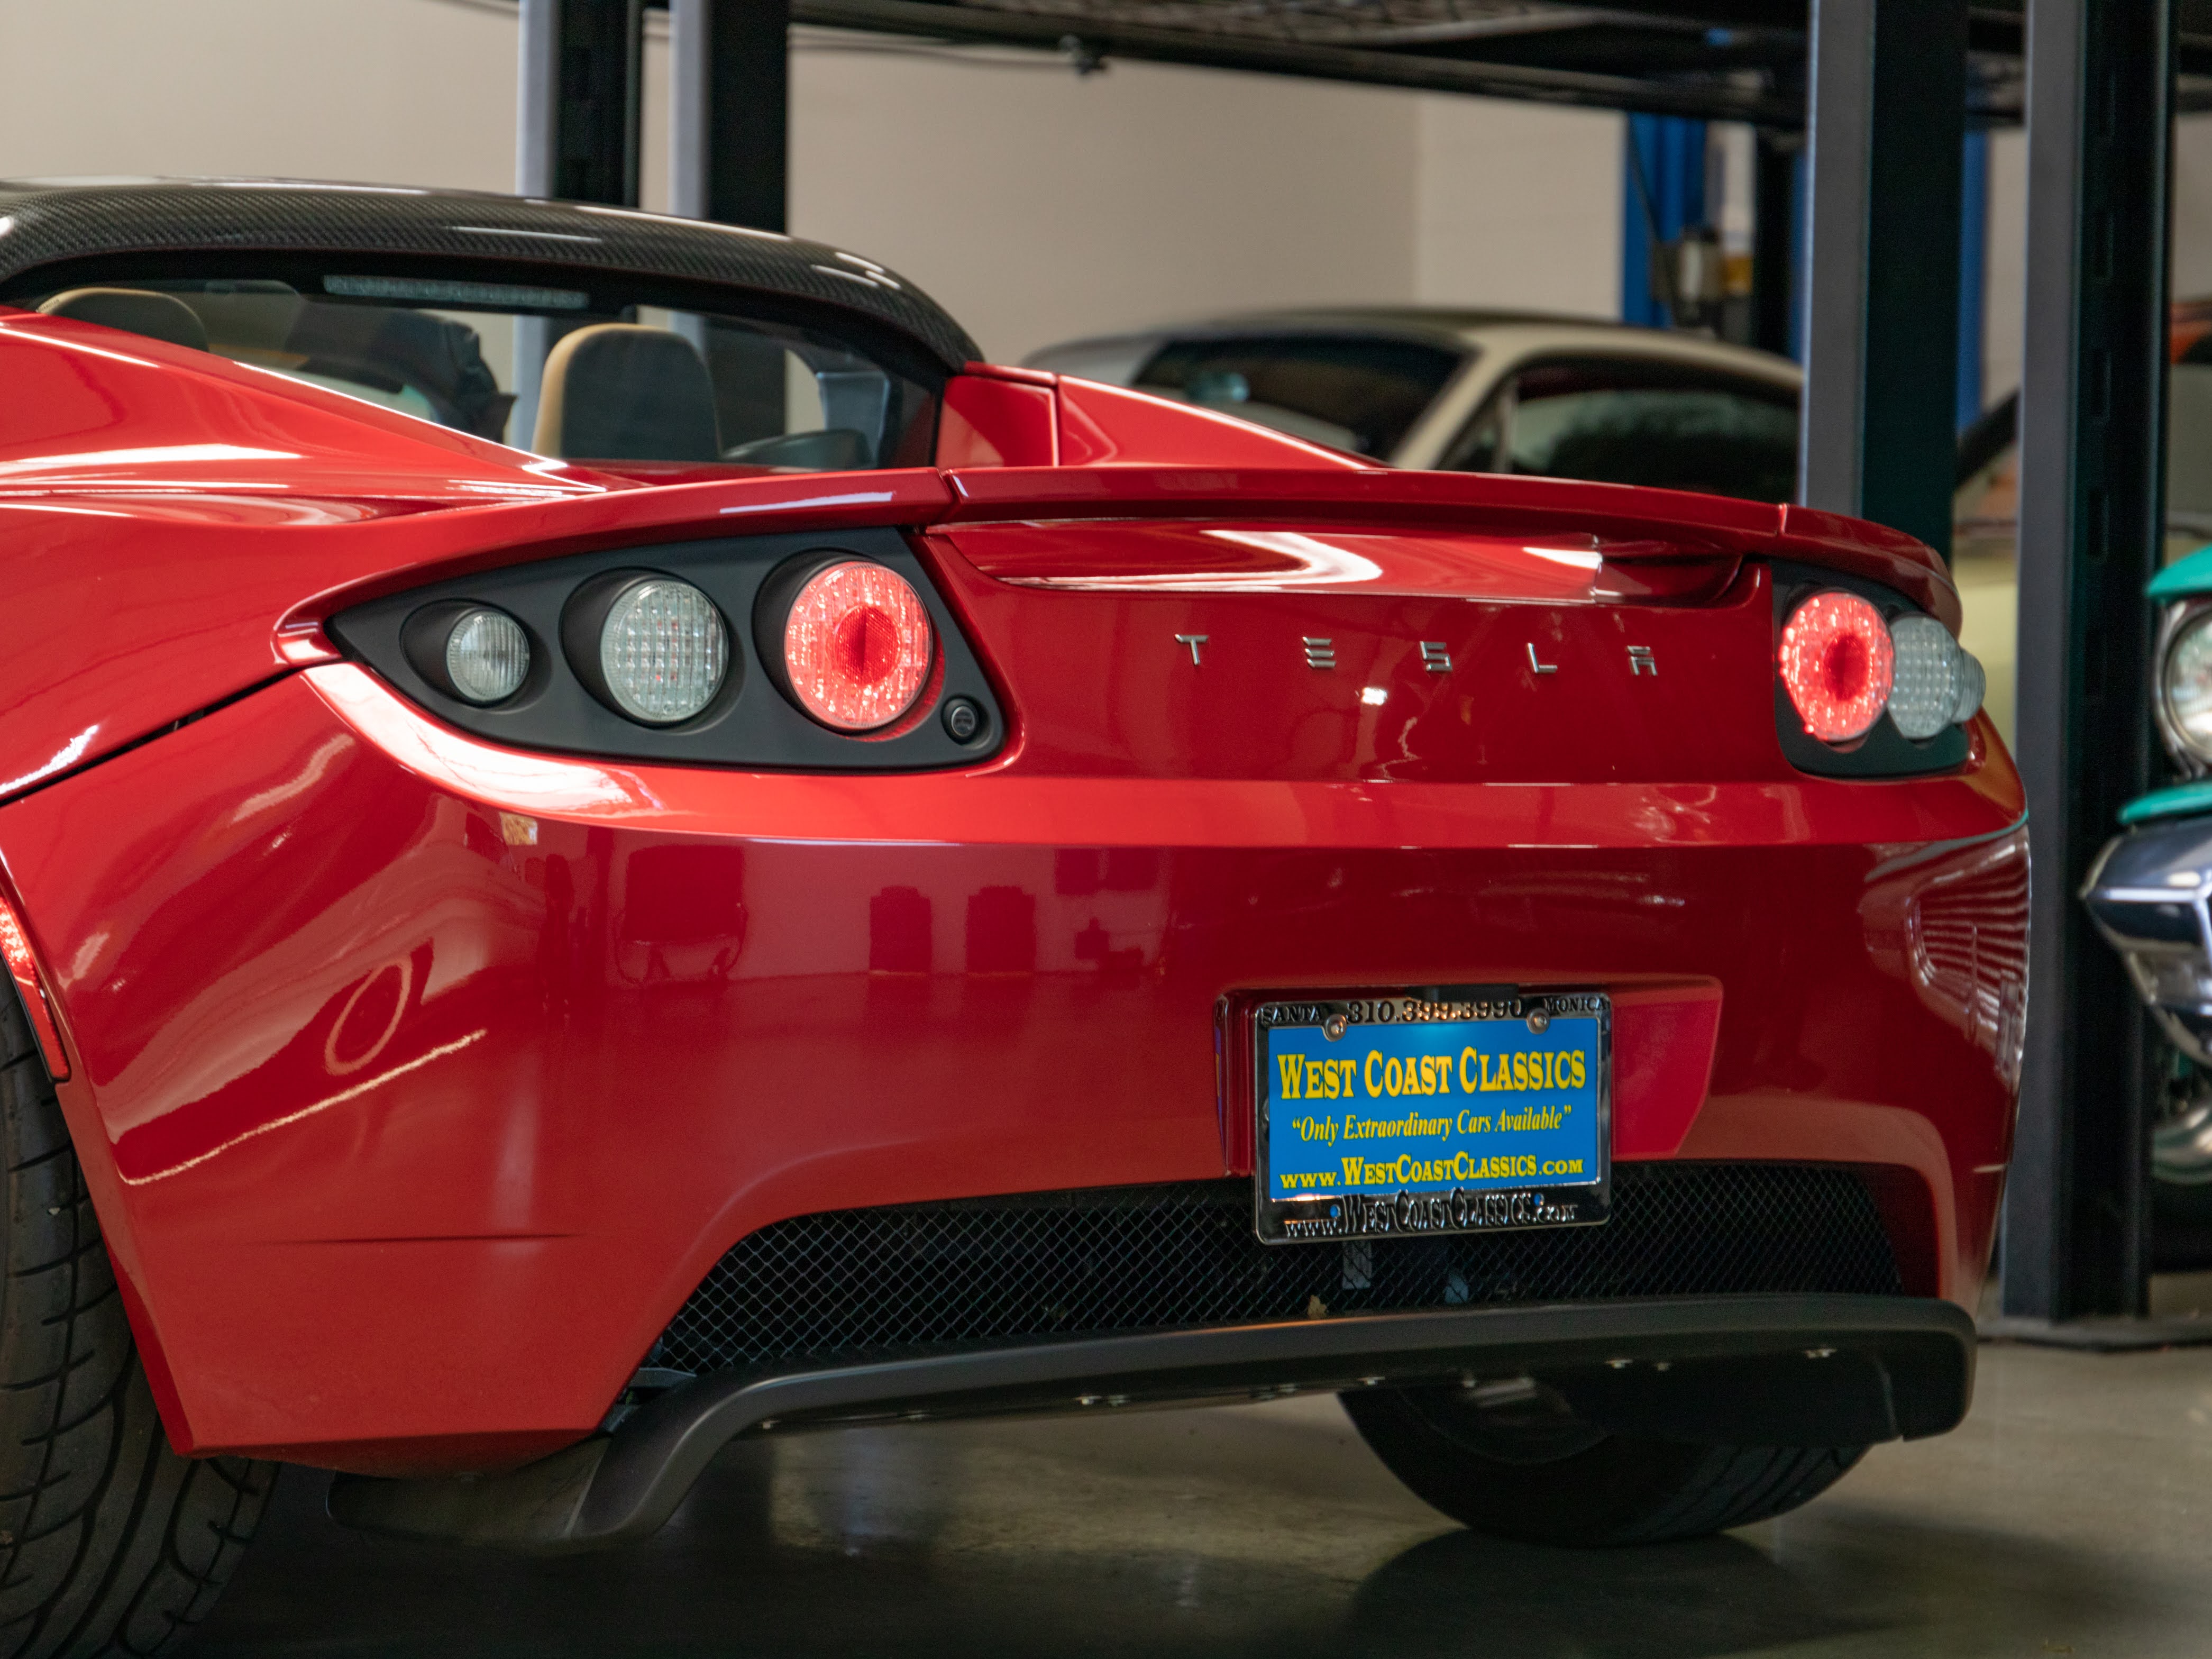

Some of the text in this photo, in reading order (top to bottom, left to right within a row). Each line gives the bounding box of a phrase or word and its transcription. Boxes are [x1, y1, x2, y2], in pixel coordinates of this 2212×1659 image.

[1174, 633, 1658, 677] TESLA
[1260, 997, 1606, 1024] SANTA 310.399.3990 MONICA
[1277, 1046, 1586, 1099] WEST COAST CLASSICS
[1343, 1112, 1453, 1142] Extraordinary
[1457, 1109, 1492, 1135] Cars
